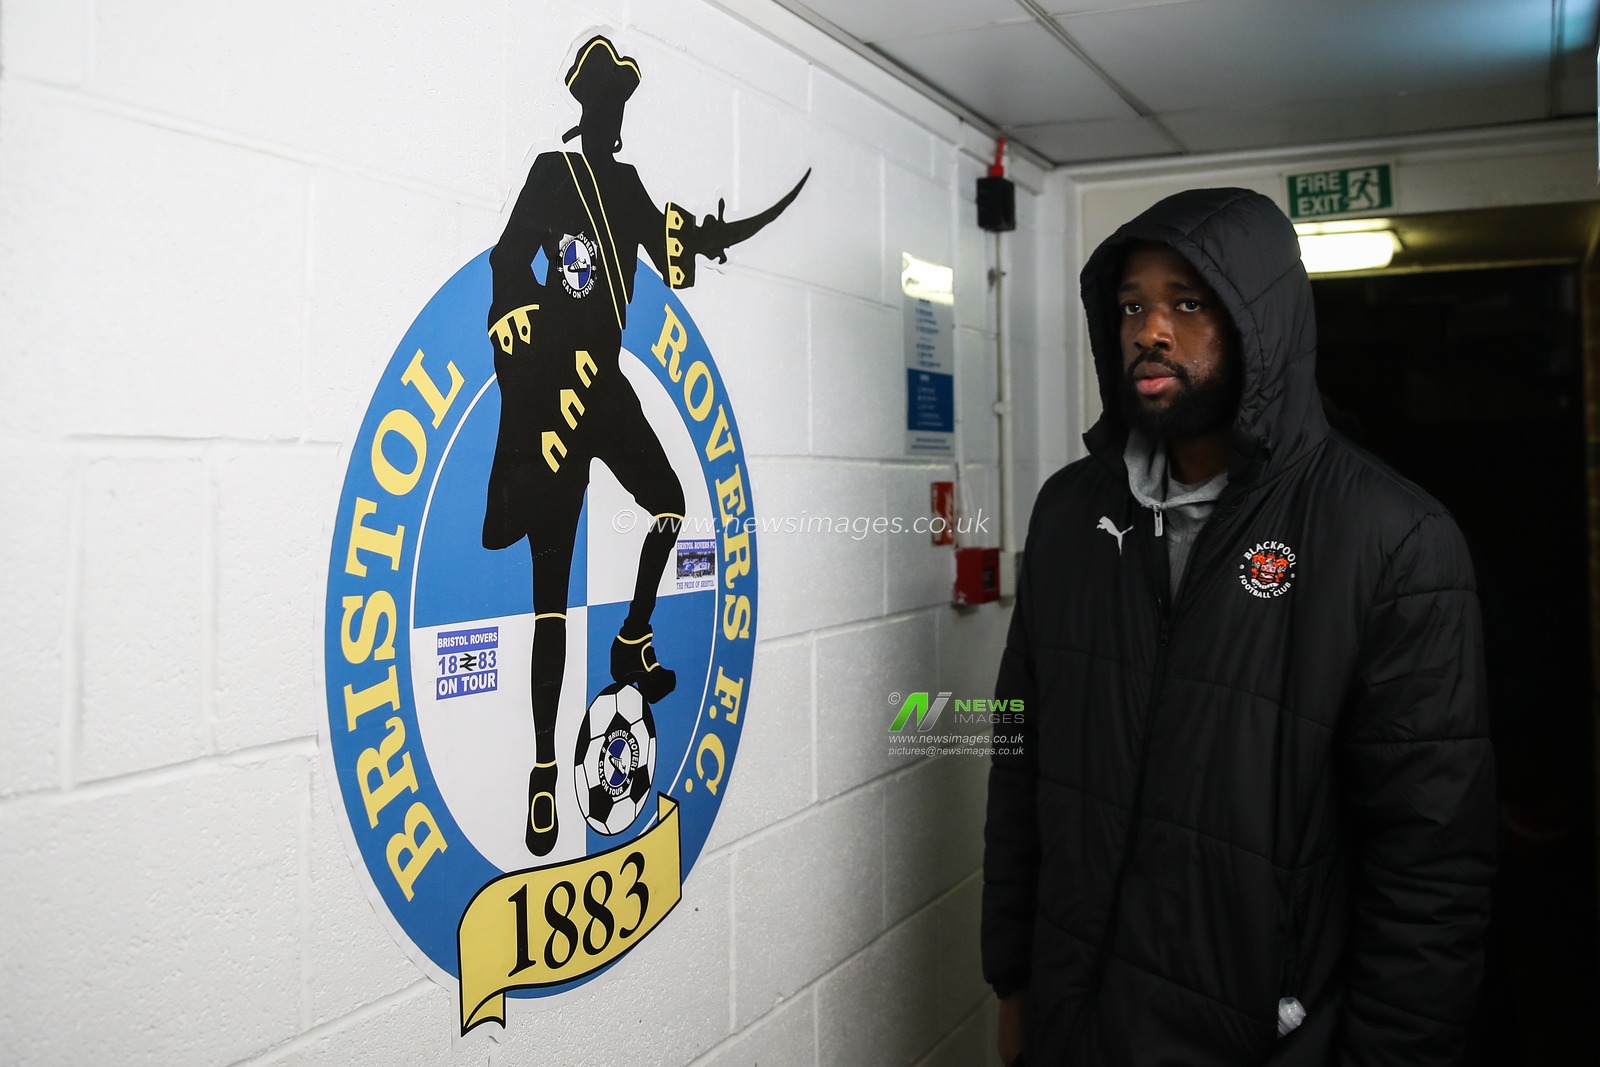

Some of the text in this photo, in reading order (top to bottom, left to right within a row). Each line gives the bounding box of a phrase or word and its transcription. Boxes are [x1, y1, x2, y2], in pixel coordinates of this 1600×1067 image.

[1296, 173, 1341, 195] FIRE
[1297, 193, 1342, 216] EXIT
[562, 279, 595, 299] GAS ON TOUR
[651, 304, 750, 796] ROVERS F.C.
[677, 542, 693, 550] BRISTOL
[694, 541, 709, 549] ROVERS
[1243, 541, 1297, 568] BLACKPOOL
[684, 581, 695, 589] PRIDE
[695, 580, 700, 588] OF
[700, 580, 715, 588] BRISTOL
[1239, 574, 1271, 599] FOOTBALL
[1273, 581, 1292, 597] CLUB
[341, 349, 465, 902] BRISTOL
[438, 632, 498, 648] BRISTOL ROVERS
[438, 650, 497, 675] 18 83
[438, 672, 496, 696] ON TOUR
[608, 730, 639, 771] BRISTOL ROVERS
[601, 779, 609, 792] ON
[608, 786, 624, 796] TOUR
[507, 851, 650, 978] 1883
